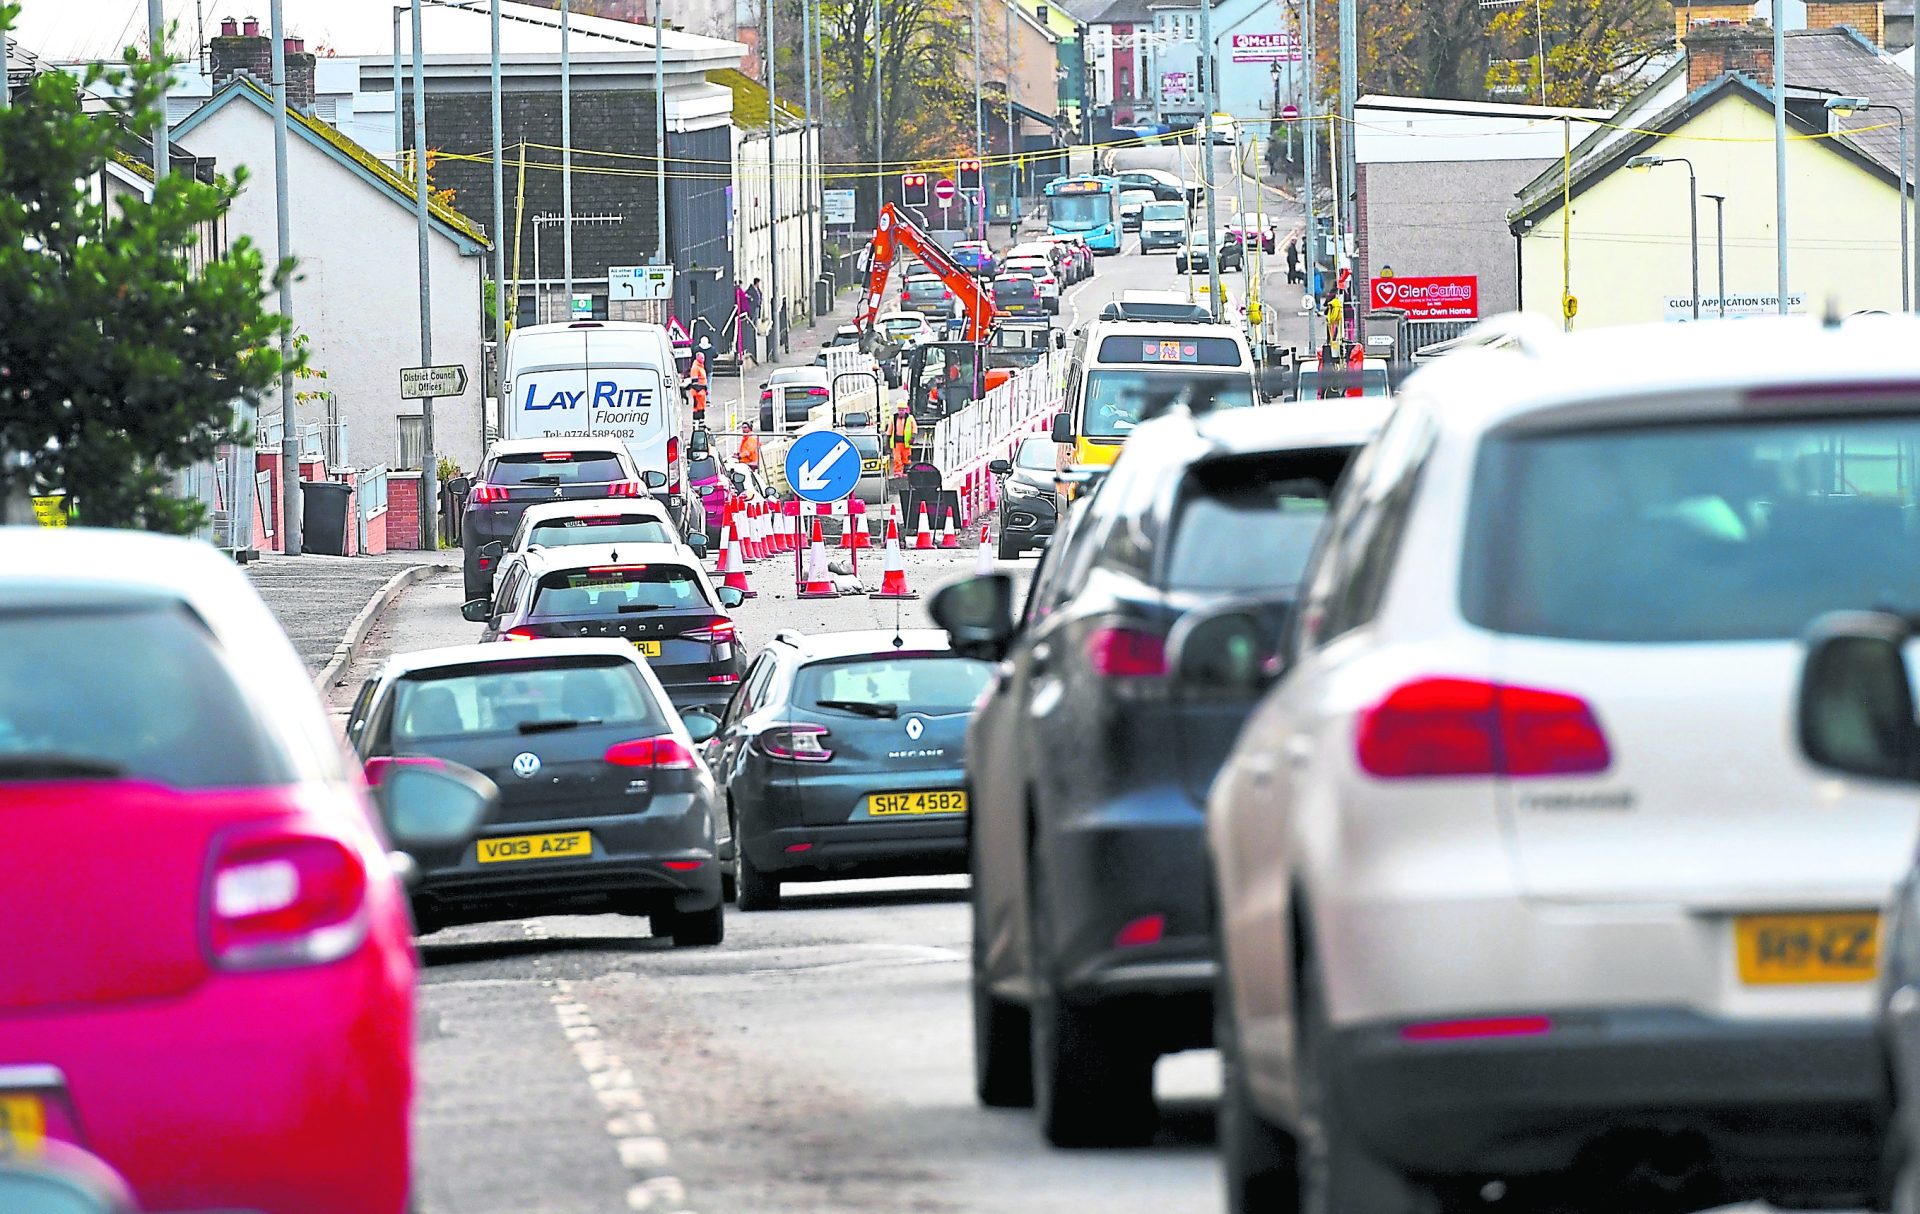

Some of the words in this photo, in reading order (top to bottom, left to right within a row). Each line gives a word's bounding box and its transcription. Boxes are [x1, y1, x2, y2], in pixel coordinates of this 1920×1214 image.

[1249, 35, 1302, 46] McLERN
[1398, 283, 1471, 299] GlenCaring
[1670, 299, 1699, 307] CLOU
[1702, 298, 1758, 306] APPICATION
[1761, 297, 1801, 305] SERES
[404, 373, 428, 381] District
[431, 371, 455, 379] Council
[419, 383, 441, 391] Offices
[525, 384, 586, 410] LAY
[592, 381, 653, 408] RITE
[595, 410, 649, 425] Flooring
[634, 643, 654, 655] RL
[876, 796, 910, 812] SHZ
[916, 794, 962, 809] 4582
[541, 836, 580, 852] AZF
